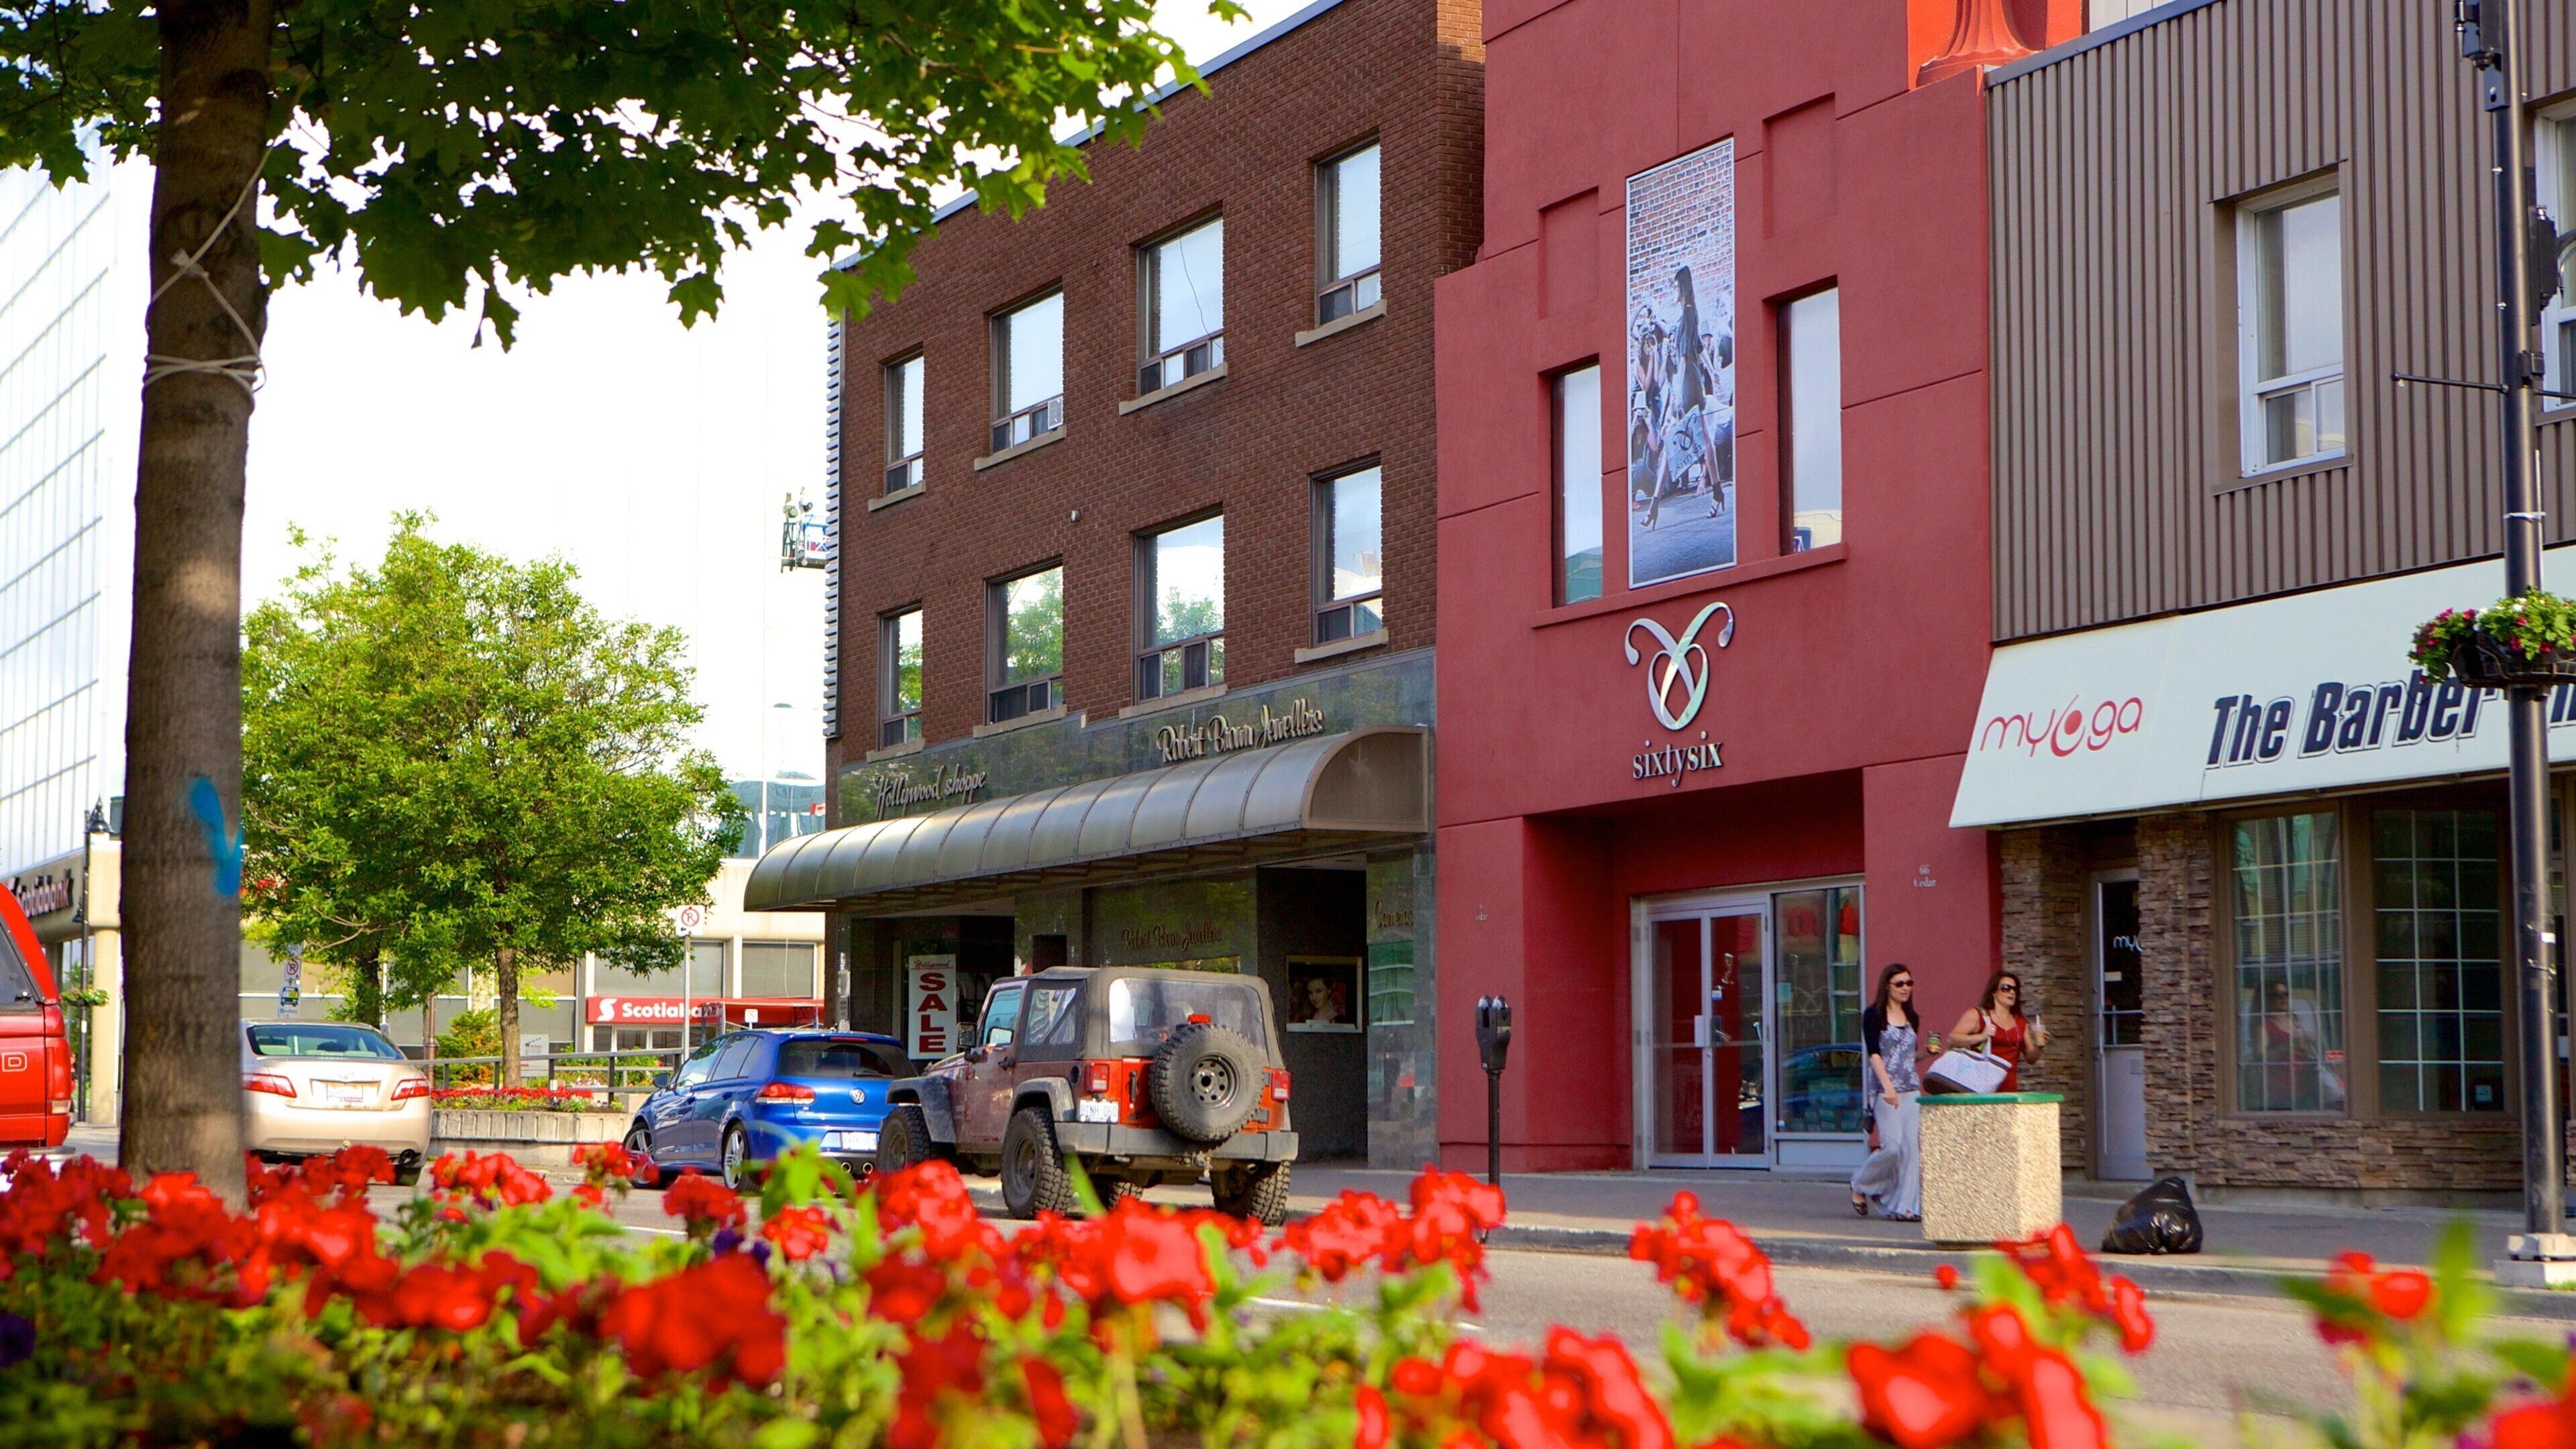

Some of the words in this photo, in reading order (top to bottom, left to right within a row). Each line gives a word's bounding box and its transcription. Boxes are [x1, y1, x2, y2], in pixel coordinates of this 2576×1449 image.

[1157, 724, 1207, 763] Robert
[1208, 715, 1254, 753] Brown
[1255, 698, 1324, 749] Jewellers
[2206, 694, 2292, 766] The
[2299, 669, 2497, 755] Barber
[1632, 731, 1723, 788] sixtysix
[873, 765, 945, 820] Hollywood
[945, 763, 987, 804] shoppe
[1121, 928, 1150, 951] Robert
[1181, 920, 1222, 952] Jewellers
[917, 972, 949, 1053] SALE
